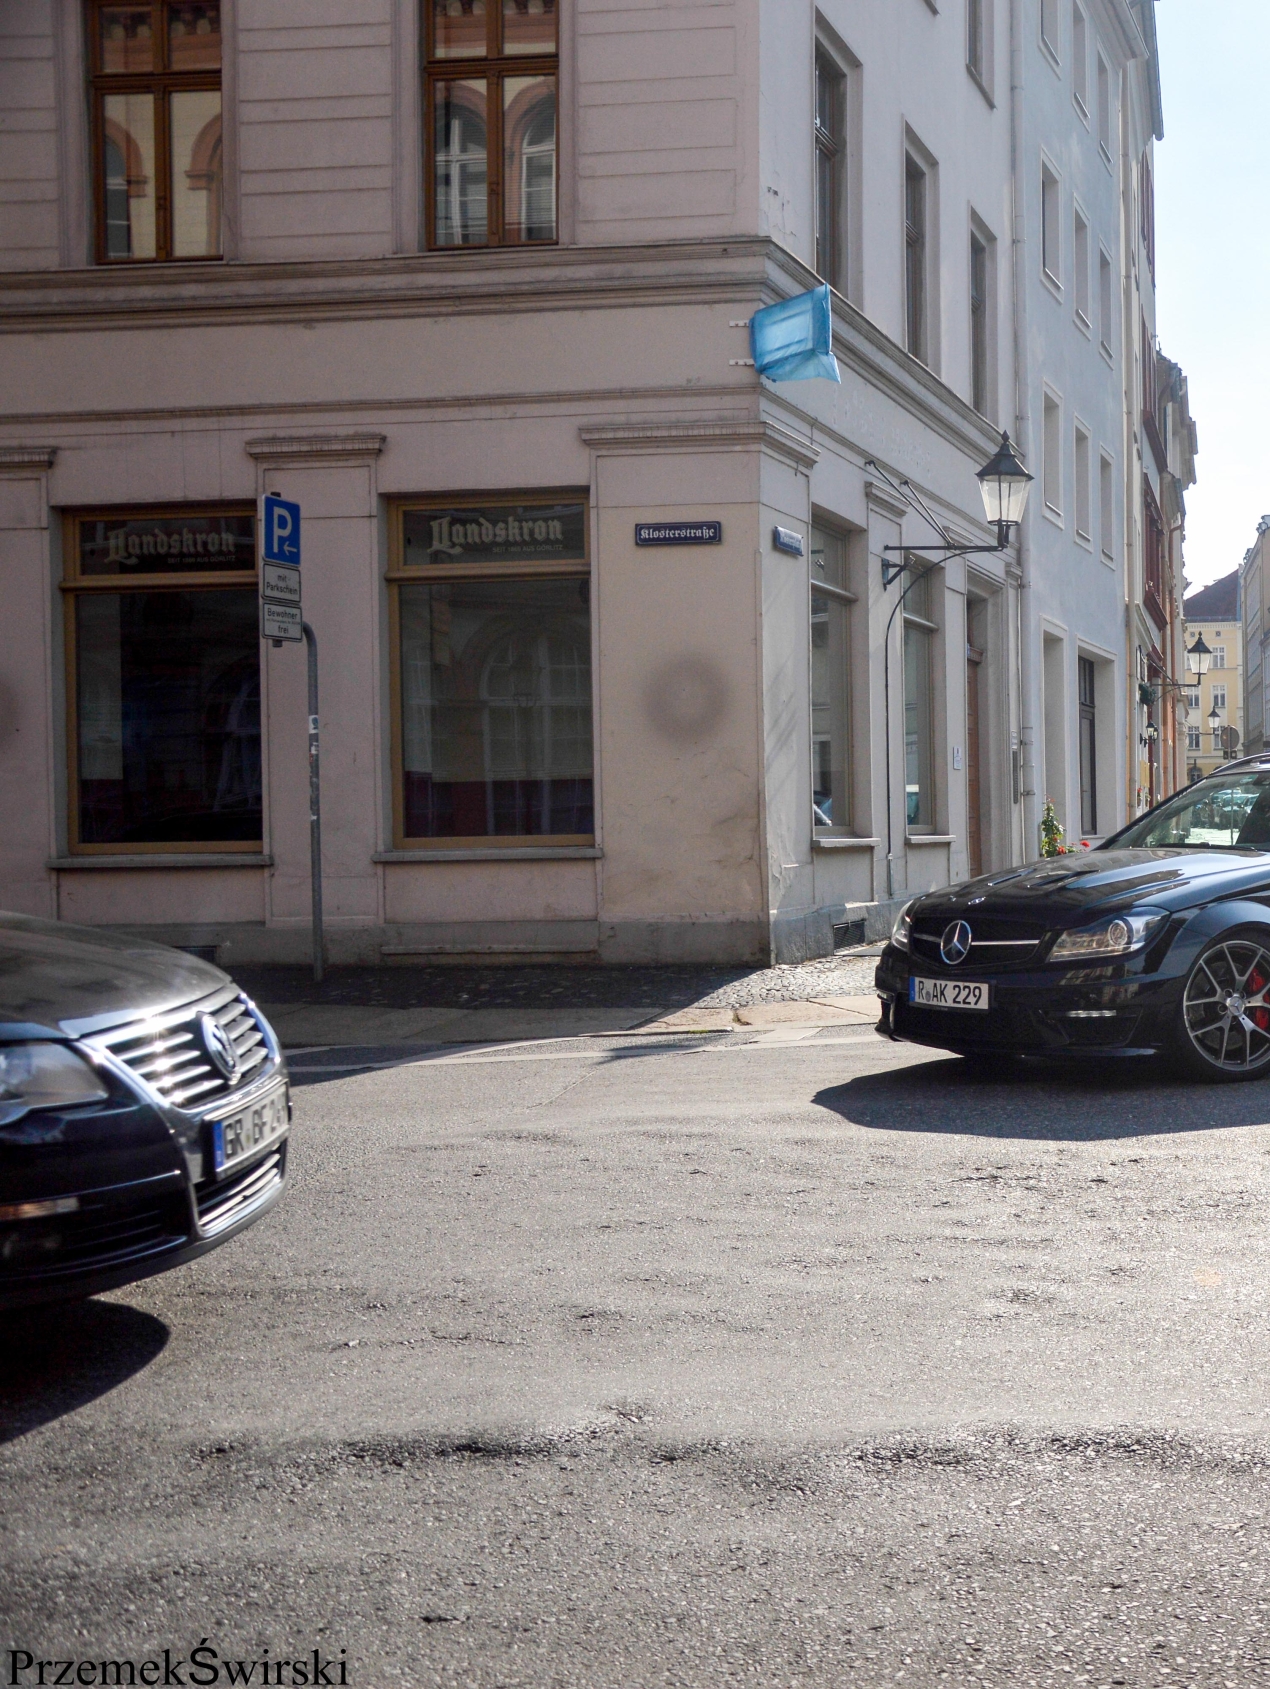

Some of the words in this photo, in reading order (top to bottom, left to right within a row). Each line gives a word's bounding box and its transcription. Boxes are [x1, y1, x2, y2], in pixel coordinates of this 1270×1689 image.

[272, 506, 293, 553] P
[427, 516, 564, 555] Landskron
[640, 526, 715, 540] Klosterstraße
[104, 527, 236, 565] Landskron
[277, 573, 287, 583] mit
[266, 582, 298, 595] Parkschein
[267, 607, 298, 620] Bewohner
[277, 624, 289, 635] frei
[918, 980, 925, 1000] R
[931, 982, 948, 1003] AK
[952, 984, 982, 1006] 229
[224, 1118, 244, 1160] GR
